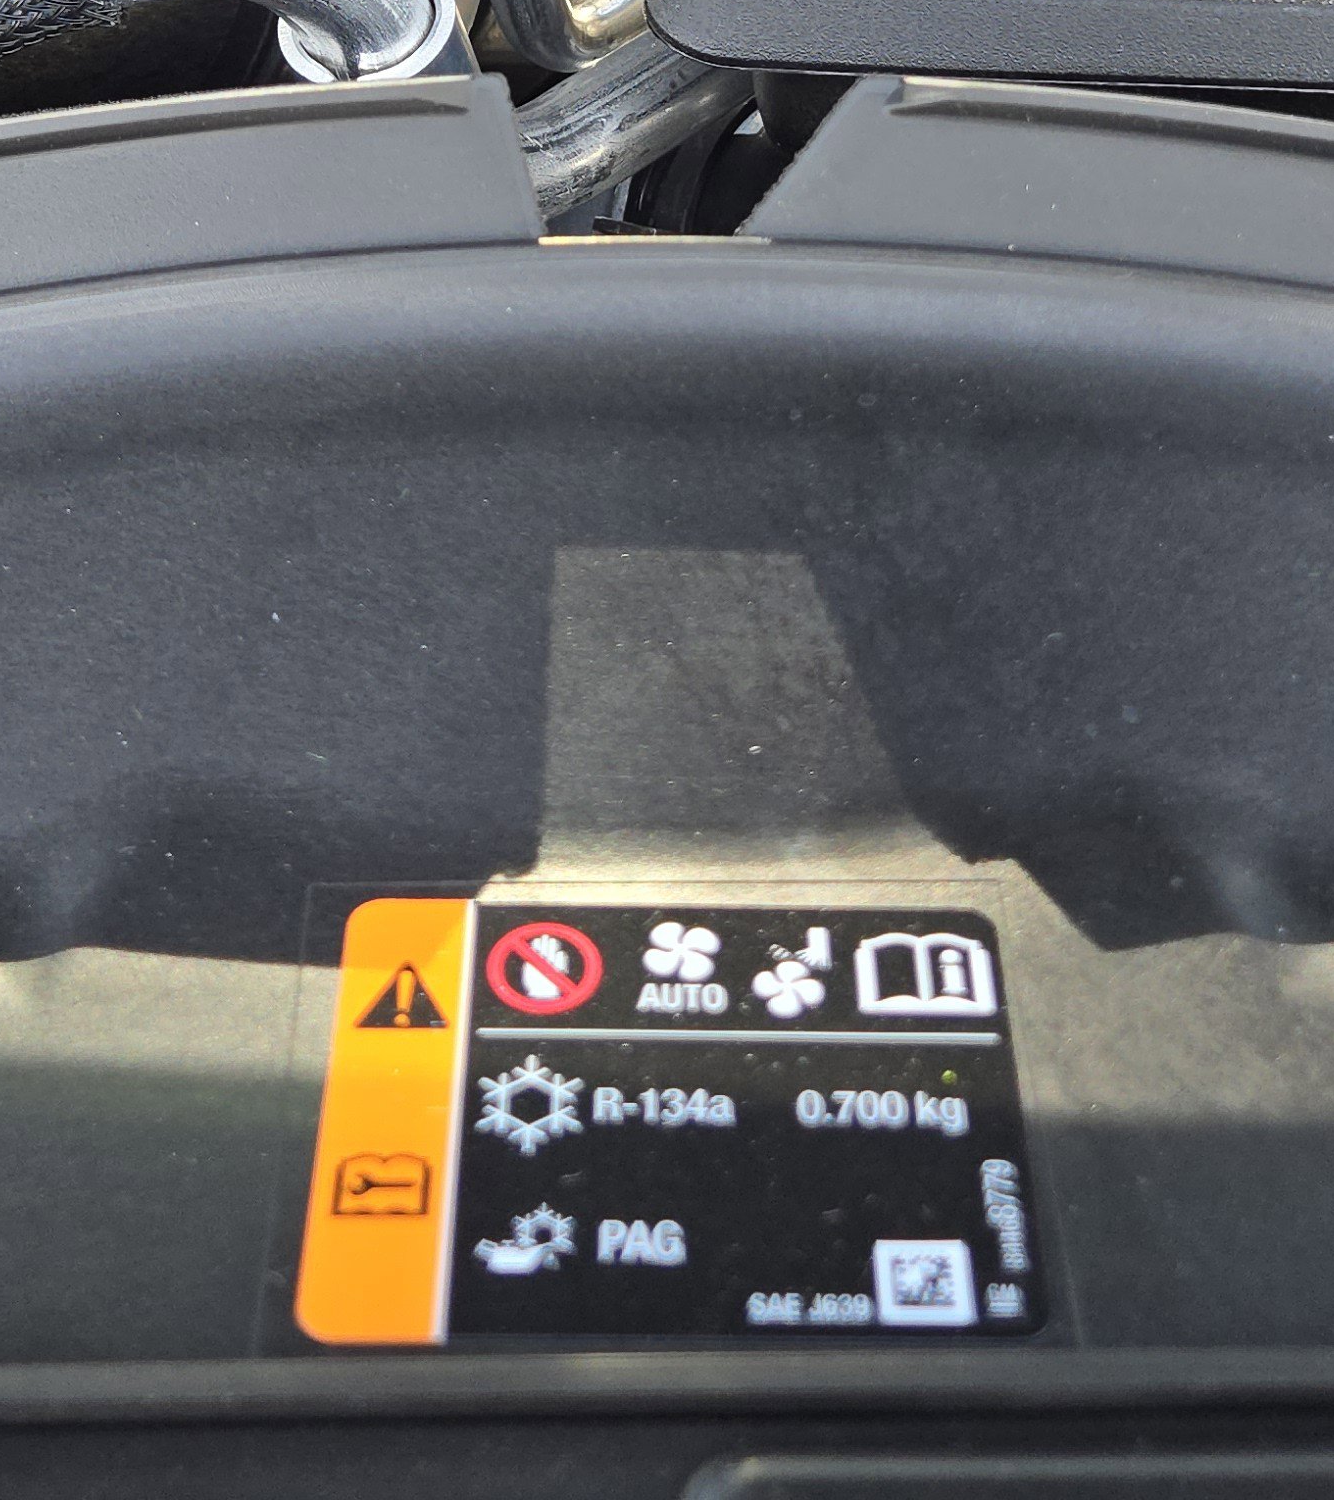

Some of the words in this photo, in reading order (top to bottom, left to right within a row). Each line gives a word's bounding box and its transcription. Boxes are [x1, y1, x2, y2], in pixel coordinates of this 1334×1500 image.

[637, 982, 728, 1015] AUTO
[593, 1087, 736, 1128] R-134a
[796, 1088, 909, 1129] 0.700
[916, 1092, 969, 1137] kg
[597, 1219, 686, 1266] PAG
[746, 1291, 803, 1324] SAE
